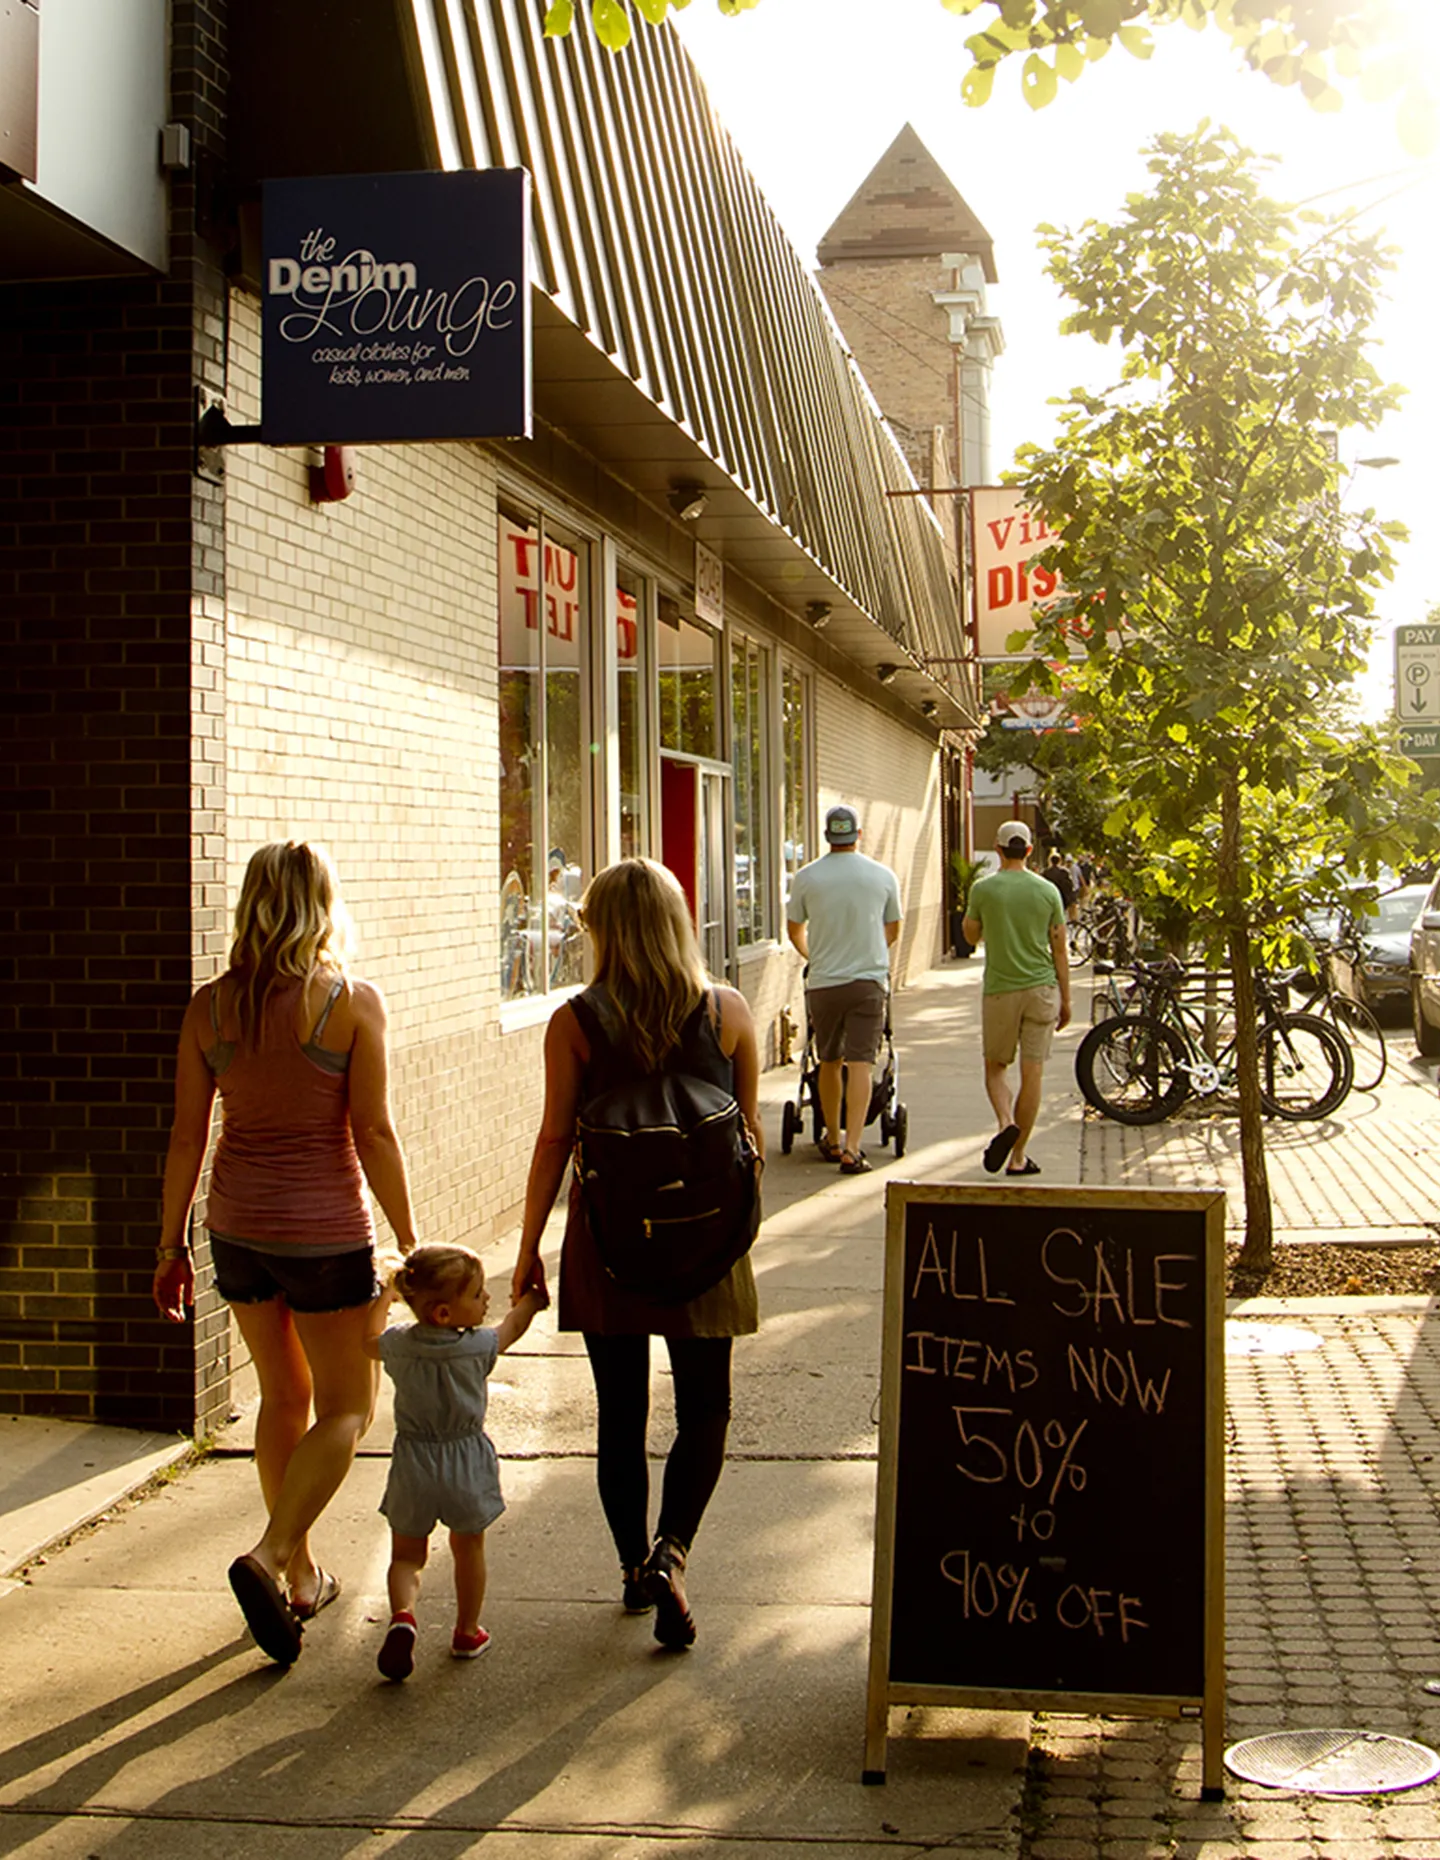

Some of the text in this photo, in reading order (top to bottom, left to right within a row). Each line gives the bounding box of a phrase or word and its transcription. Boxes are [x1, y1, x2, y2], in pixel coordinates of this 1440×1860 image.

[300, 227, 337, 263] the
[268, 251, 418, 296] Denim
[279, 249, 517, 358] Lounge
[312, 340, 437, 366] casual clothes for
[414, 361, 446, 382] and
[1404, 629, 1436, 644] PAY
[911, 1221, 1198, 1329] ALL SALE
[904, 1330, 1173, 1415] ITEMS NOW
[951, 1405, 1090, 1506] 50%
[1009, 1502, 1057, 1543] to
[940, 1548, 1151, 1645] 90% OFF
